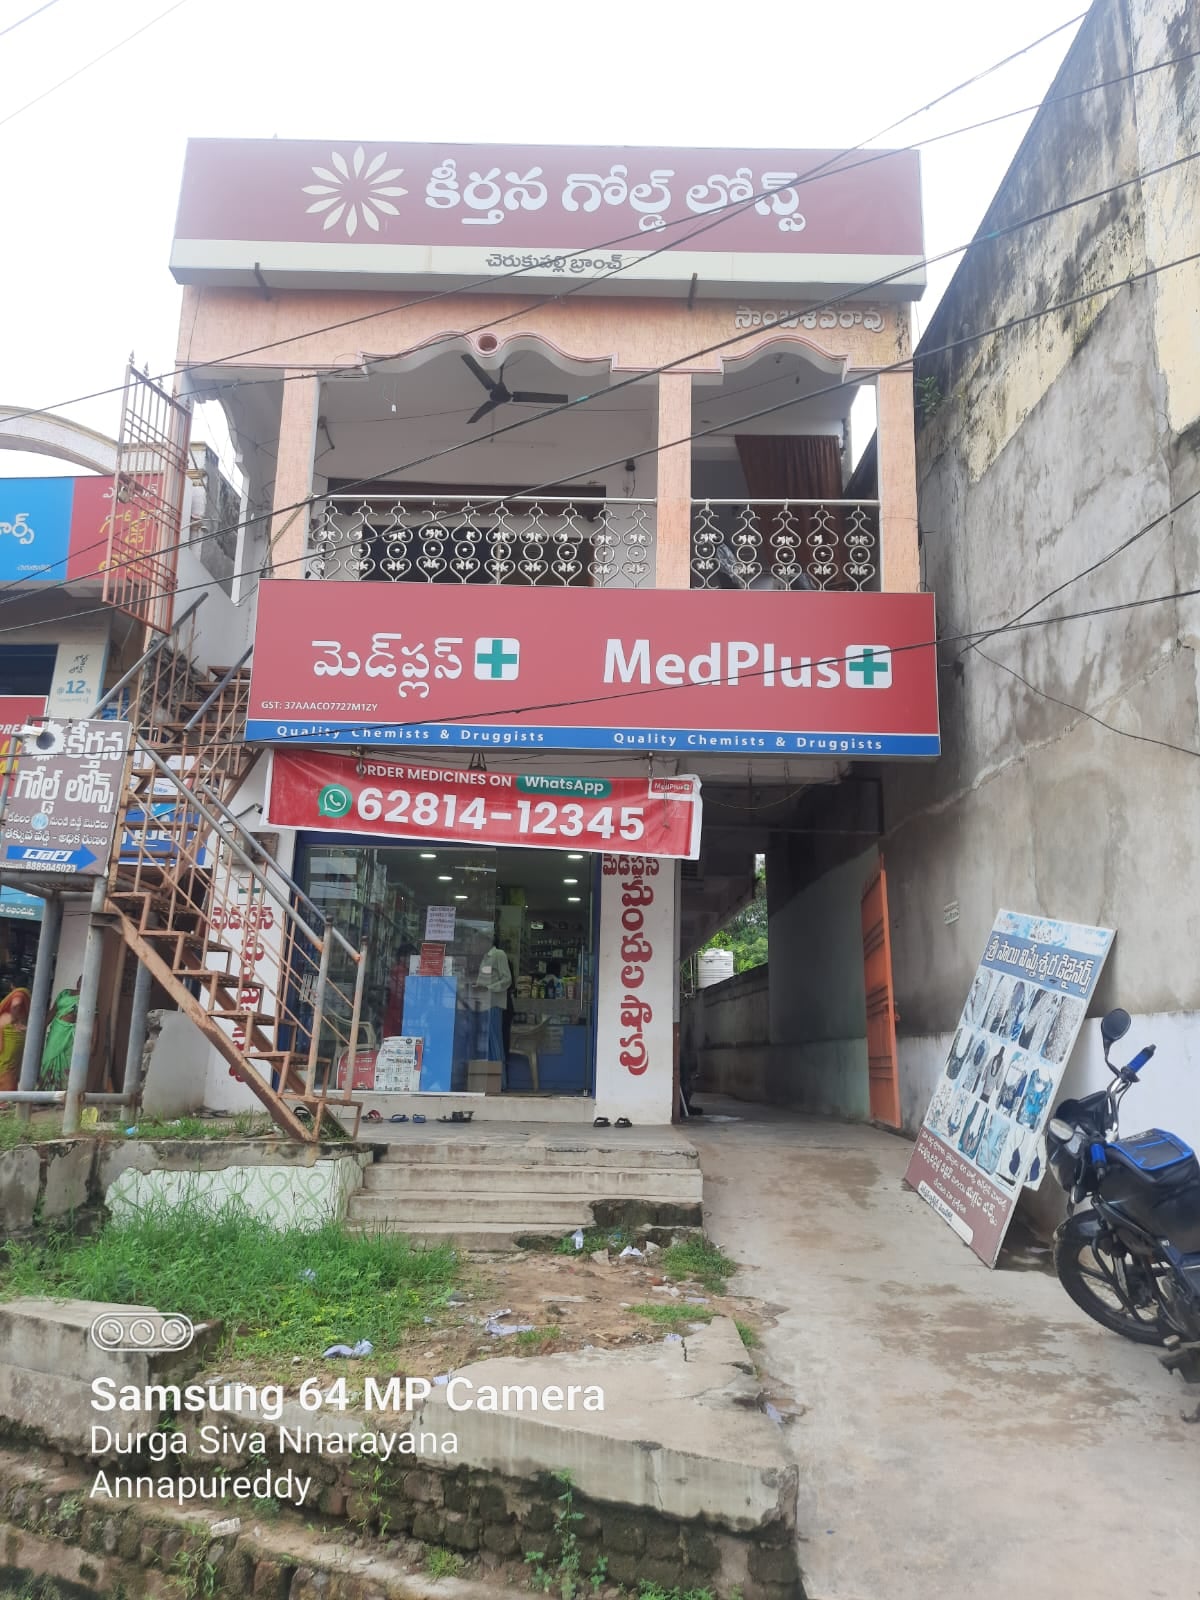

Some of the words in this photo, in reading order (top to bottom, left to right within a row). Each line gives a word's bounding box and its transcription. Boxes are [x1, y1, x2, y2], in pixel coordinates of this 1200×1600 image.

[424, 158, 549, 226] కీర్తన
[561, 164, 675, 233] గోల్డ్
[685, 167, 807, 233] లోన్స్
[603, 638, 841, 688] MedPlus
[261, 701, 282, 711] GST:
[66, 721, 122, 769] కీర్తన
[276, 724, 341, 740] Quality
[351, 728, 431, 740] Chemists
[439, 729, 450, 740] &
[460, 730, 545, 744] Druggists
[613, 732, 677, 746] Quality
[687, 734, 765, 747] Chemists
[776, 736, 786, 748] &
[797, 737, 883, 751] Druggists
[356, 765, 404, 778] ORDER
[407, 768, 486, 786] MEDICINES
[489, 774, 512, 787] ON
[525, 776, 604, 795] WhatsApp
[357, 787, 645, 841] 62814-12345
